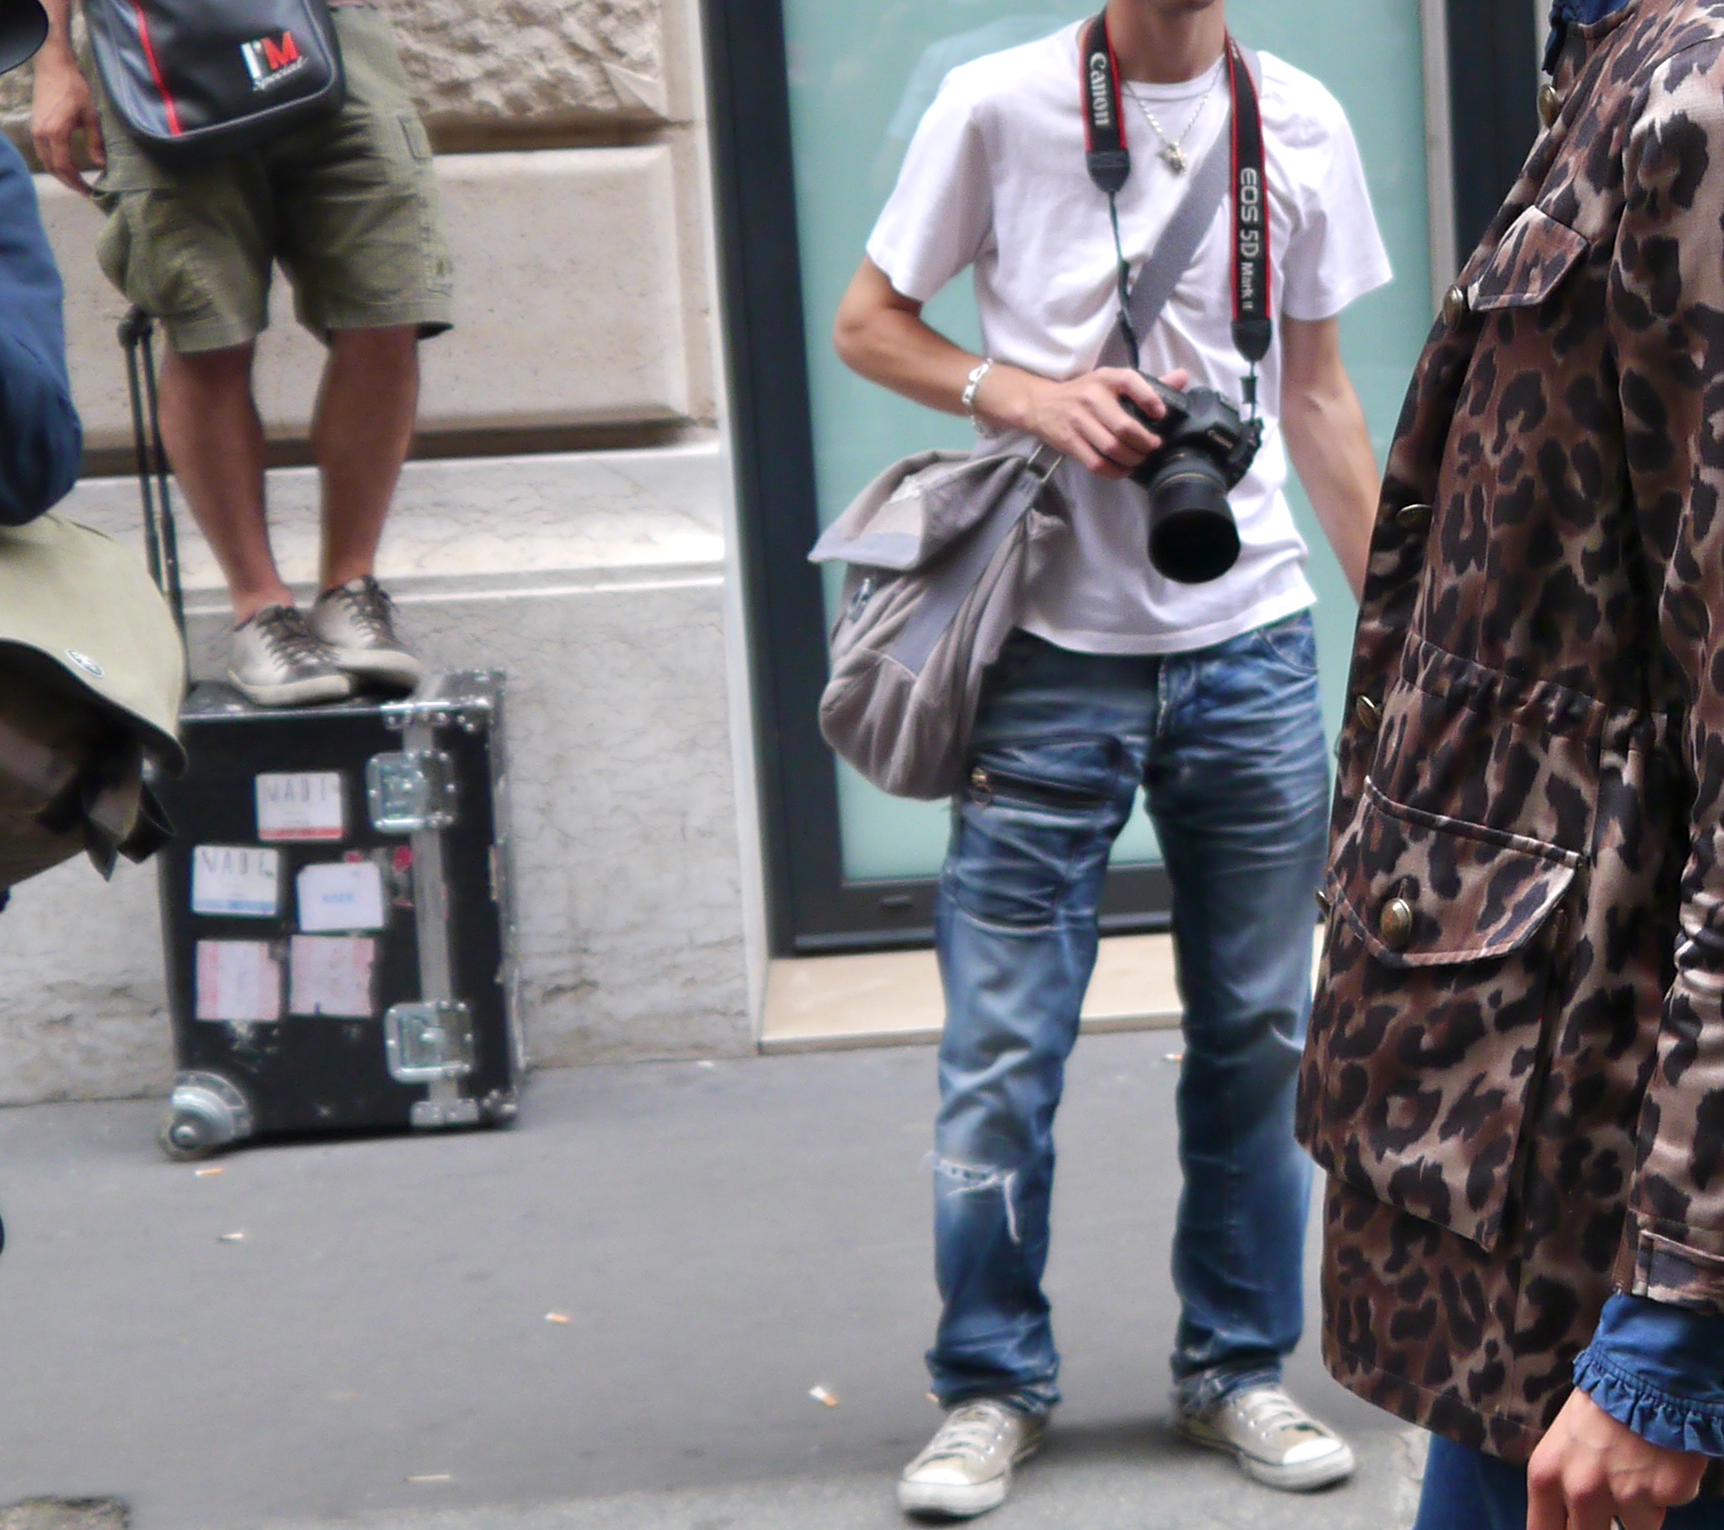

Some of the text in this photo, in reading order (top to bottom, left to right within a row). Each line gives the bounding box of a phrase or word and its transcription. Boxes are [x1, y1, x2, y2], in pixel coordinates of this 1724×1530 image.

[1090, 52, 1109, 126] Canon
[1240, 167, 1259, 222] EOS
[1240, 229, 1260, 258] 5D
[1240, 262, 1254, 299] Mark
